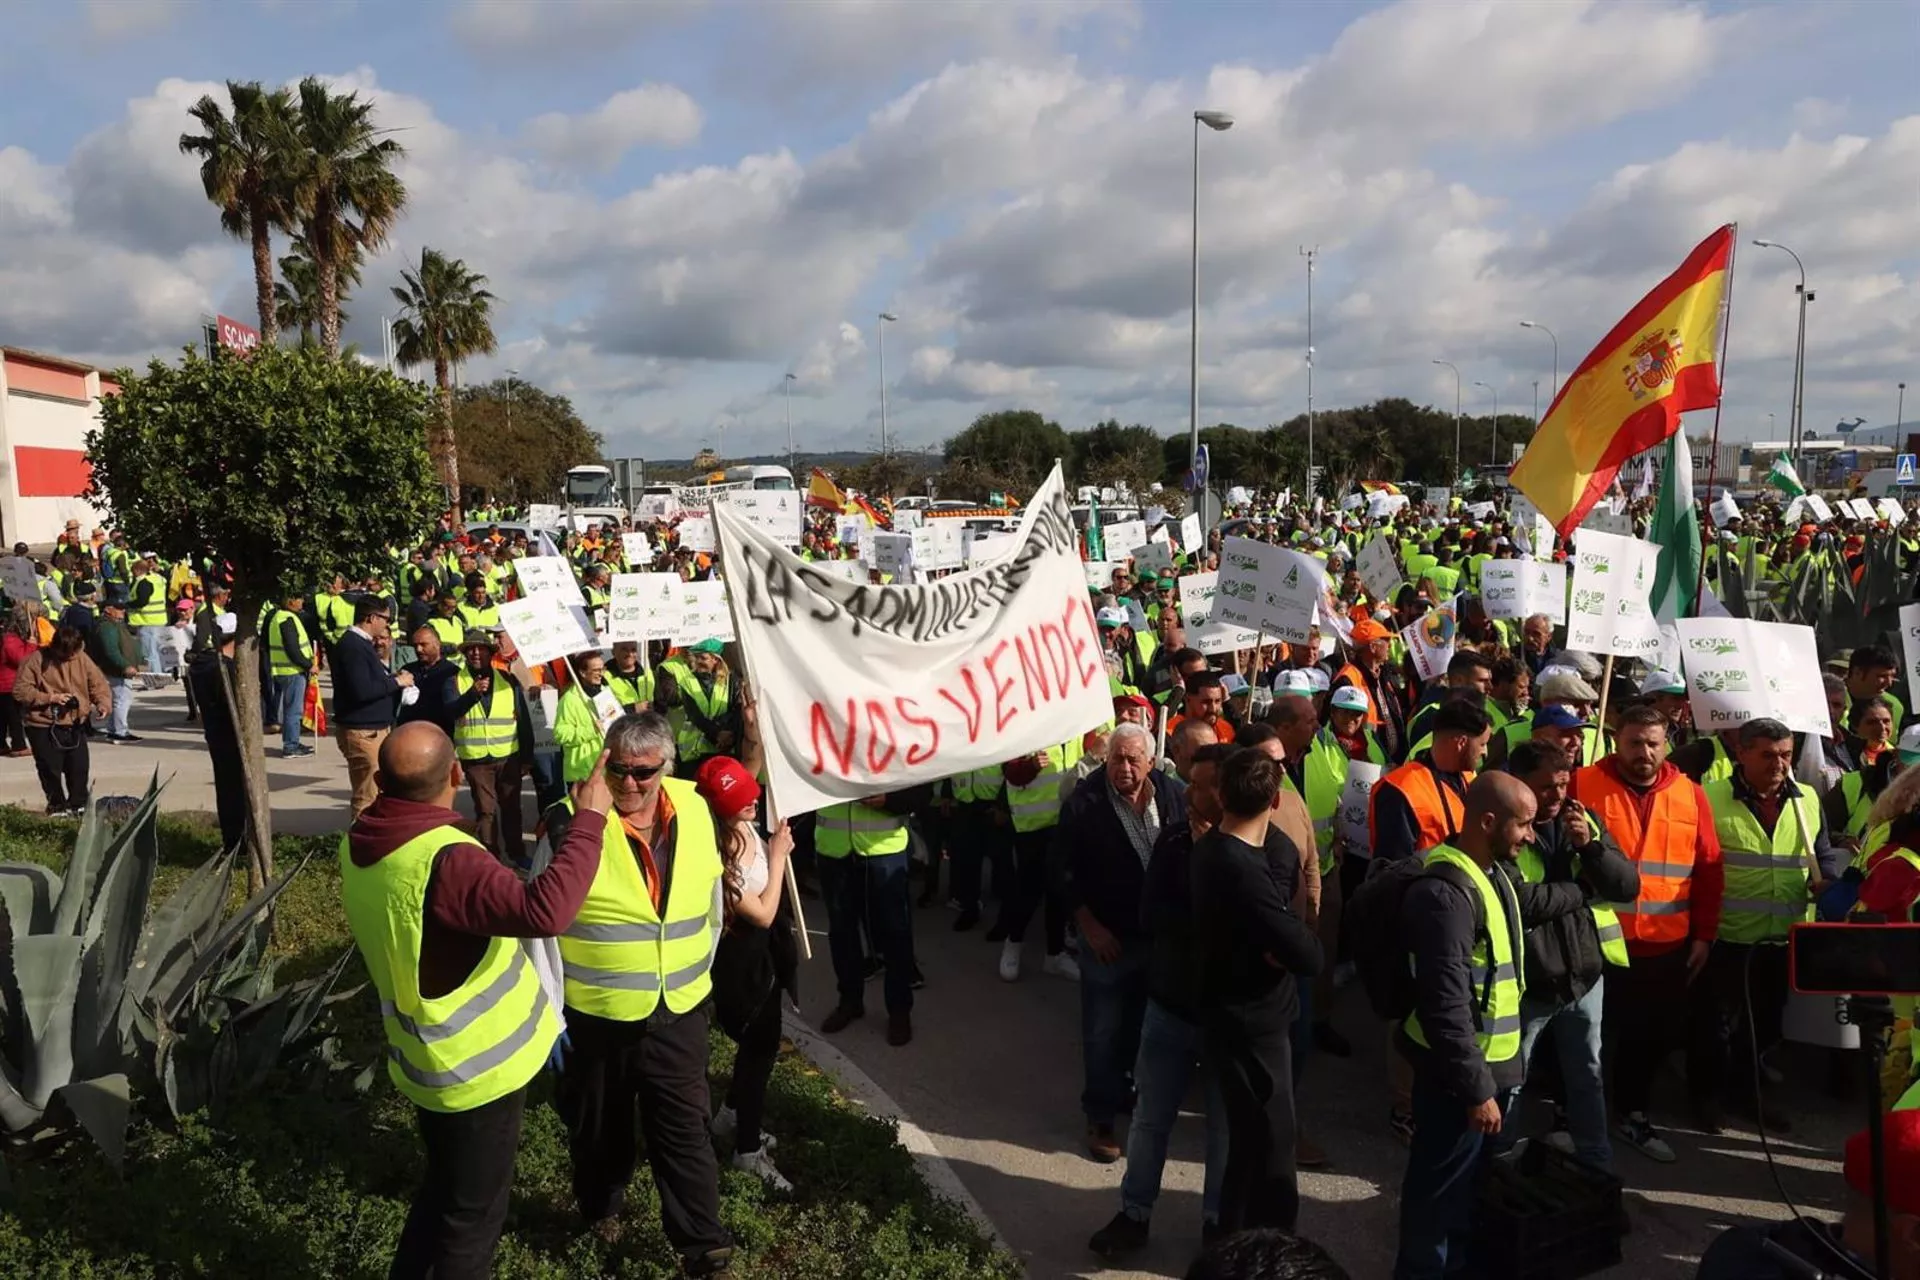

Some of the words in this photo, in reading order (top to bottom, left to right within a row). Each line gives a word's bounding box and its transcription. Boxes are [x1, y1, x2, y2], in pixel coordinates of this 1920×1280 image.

[1628, 456, 1717, 469] MASK
[741, 544, 838, 626] LAS
[1222, 608, 1236, 619] Por
[1236, 613, 1248, 622] un
[1261, 619, 1285, 635] Campo
[1285, 625, 1305, 640] Vivo
[1199, 639, 1210, 649] Por
[1211, 638, 1222, 646] un
[938, 594, 1104, 744] VENDE
[1724, 670, 1748, 681] UPA
[1710, 709, 1730, 721] Por
[1734, 709, 1751, 719] un
[810, 695, 940, 775] NOS
